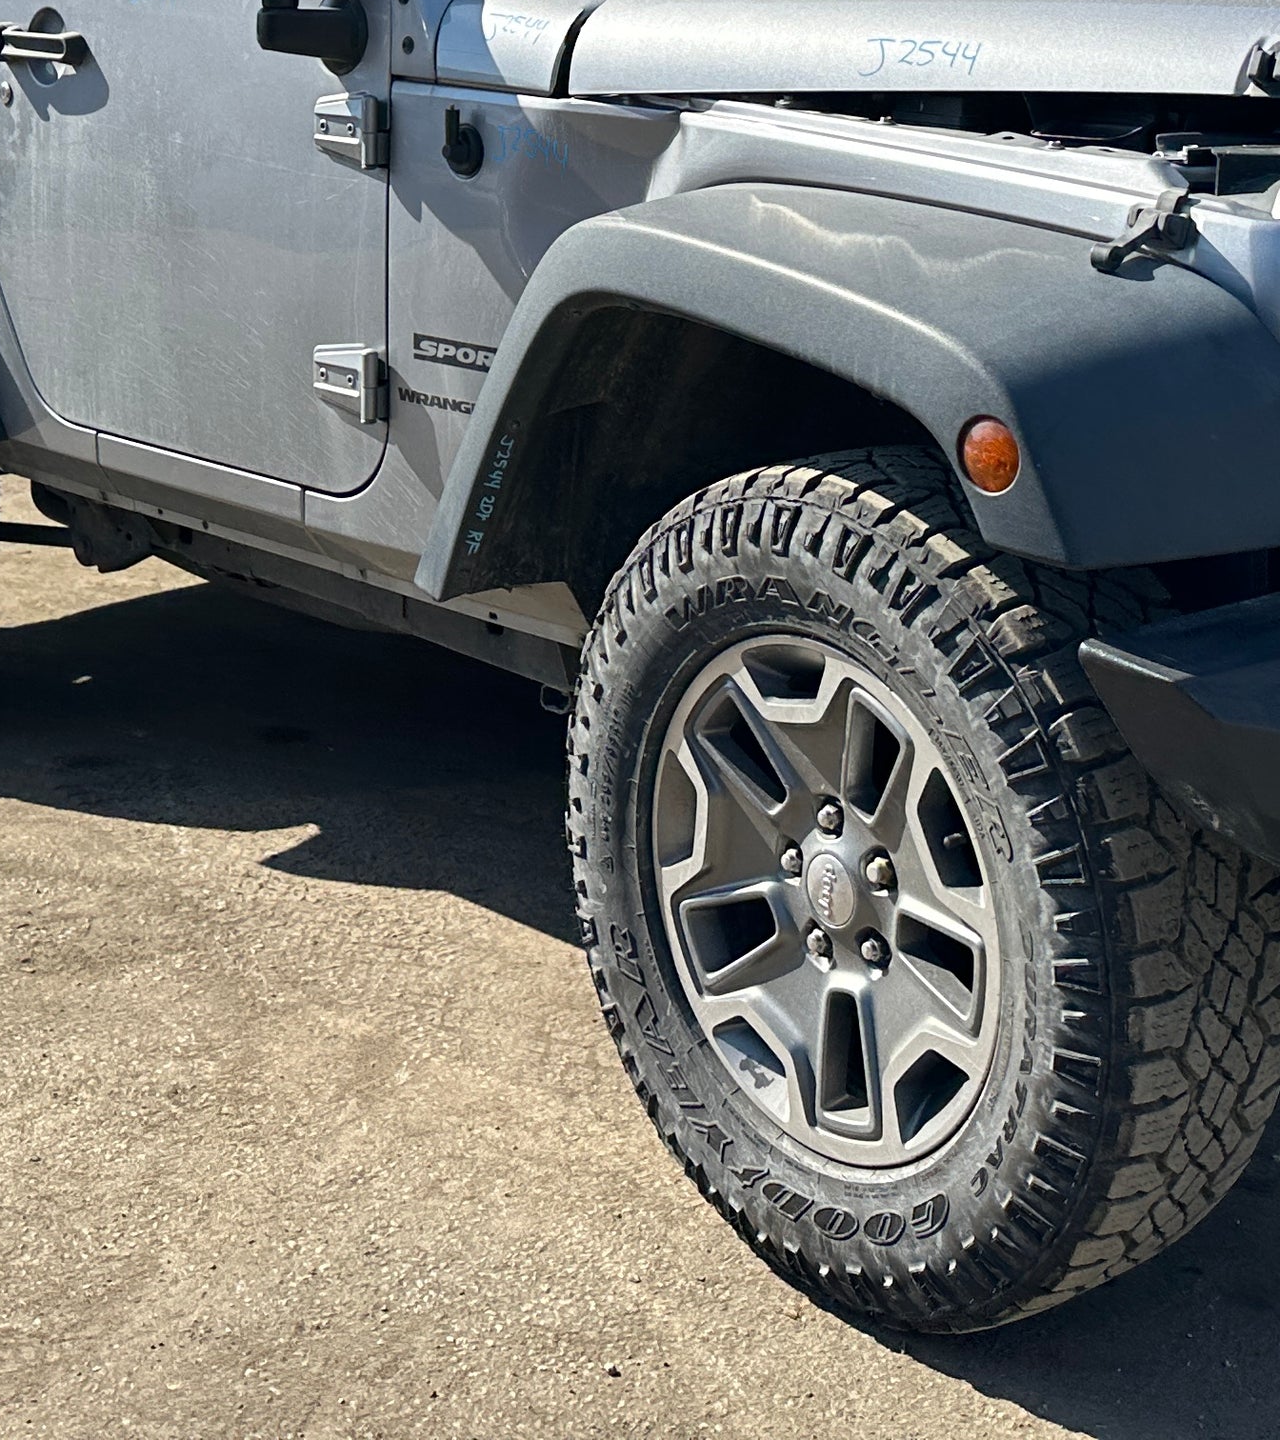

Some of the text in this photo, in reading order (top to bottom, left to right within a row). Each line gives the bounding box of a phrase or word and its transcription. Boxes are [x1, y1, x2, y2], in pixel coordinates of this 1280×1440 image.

[858, 37, 982, 77] J2544
[398, 386, 476, 415] WRANG
[483, 434, 516, 490] J2544
[464, 529, 486, 557] RF
